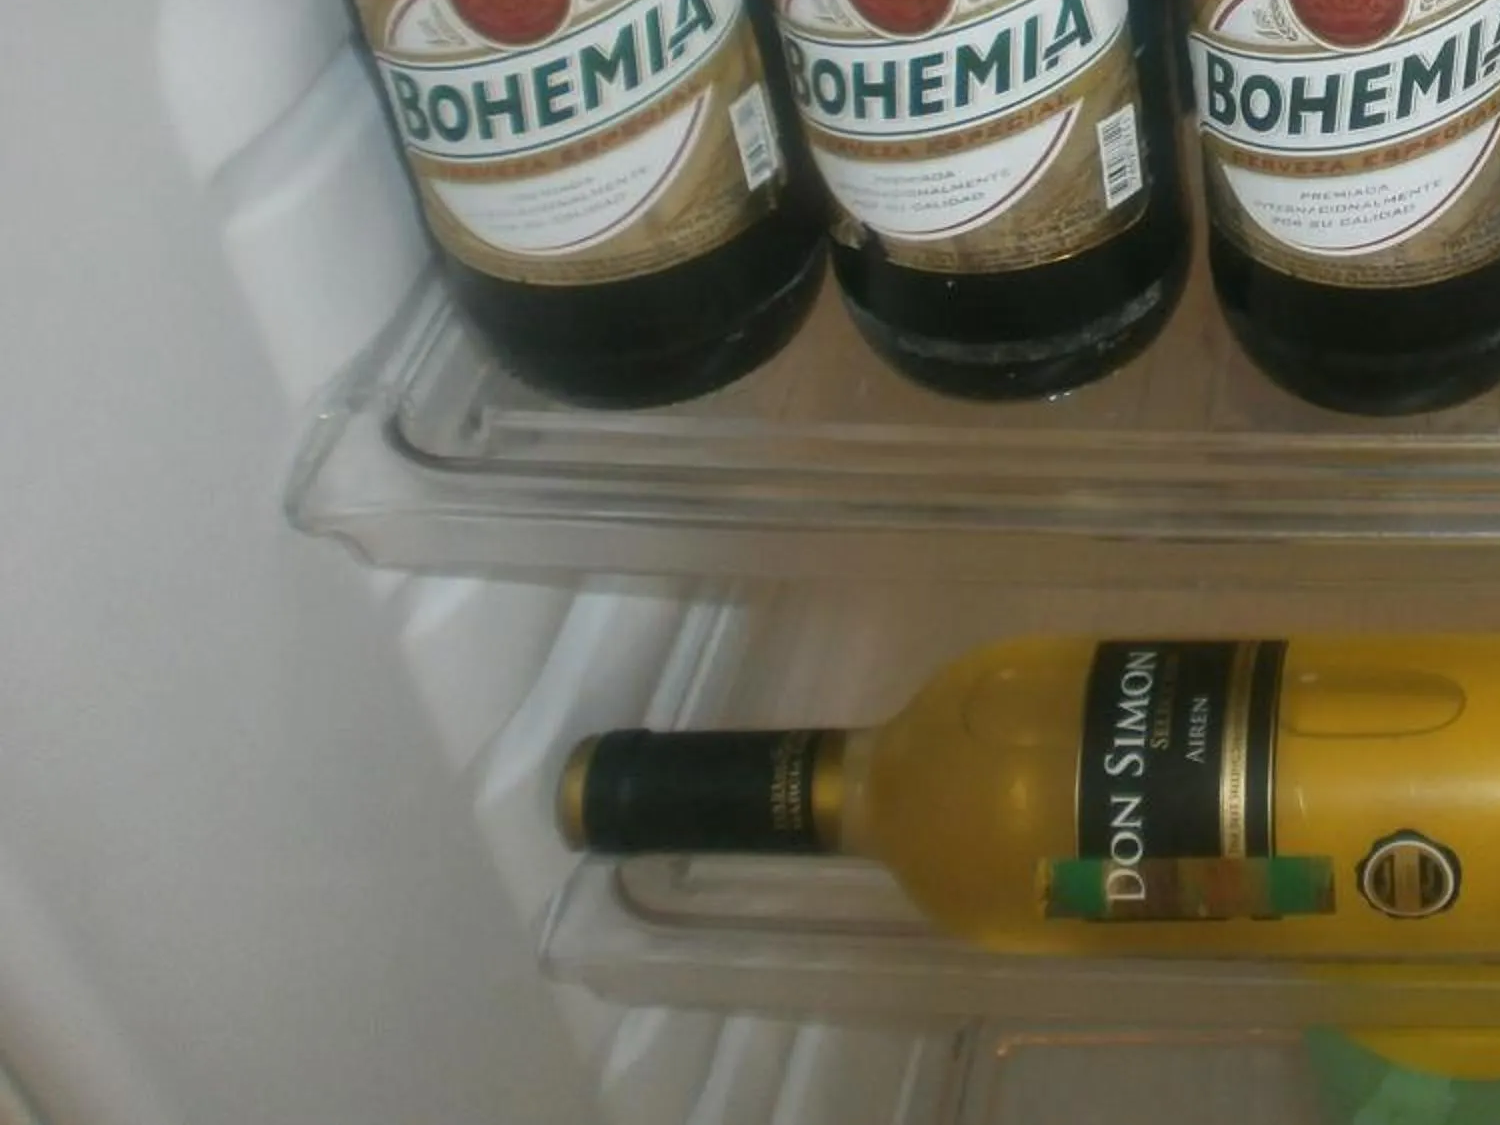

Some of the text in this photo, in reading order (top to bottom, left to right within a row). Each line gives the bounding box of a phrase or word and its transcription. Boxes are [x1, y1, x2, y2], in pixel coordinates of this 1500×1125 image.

[1233, 101, 1498, 173] CERVEZA ESPECIAL
[1300, 183, 1390, 201] PREMIADA
[1185, 696, 1209, 763] AIREN
[1104, 651, 1158, 901] DON SIMON
